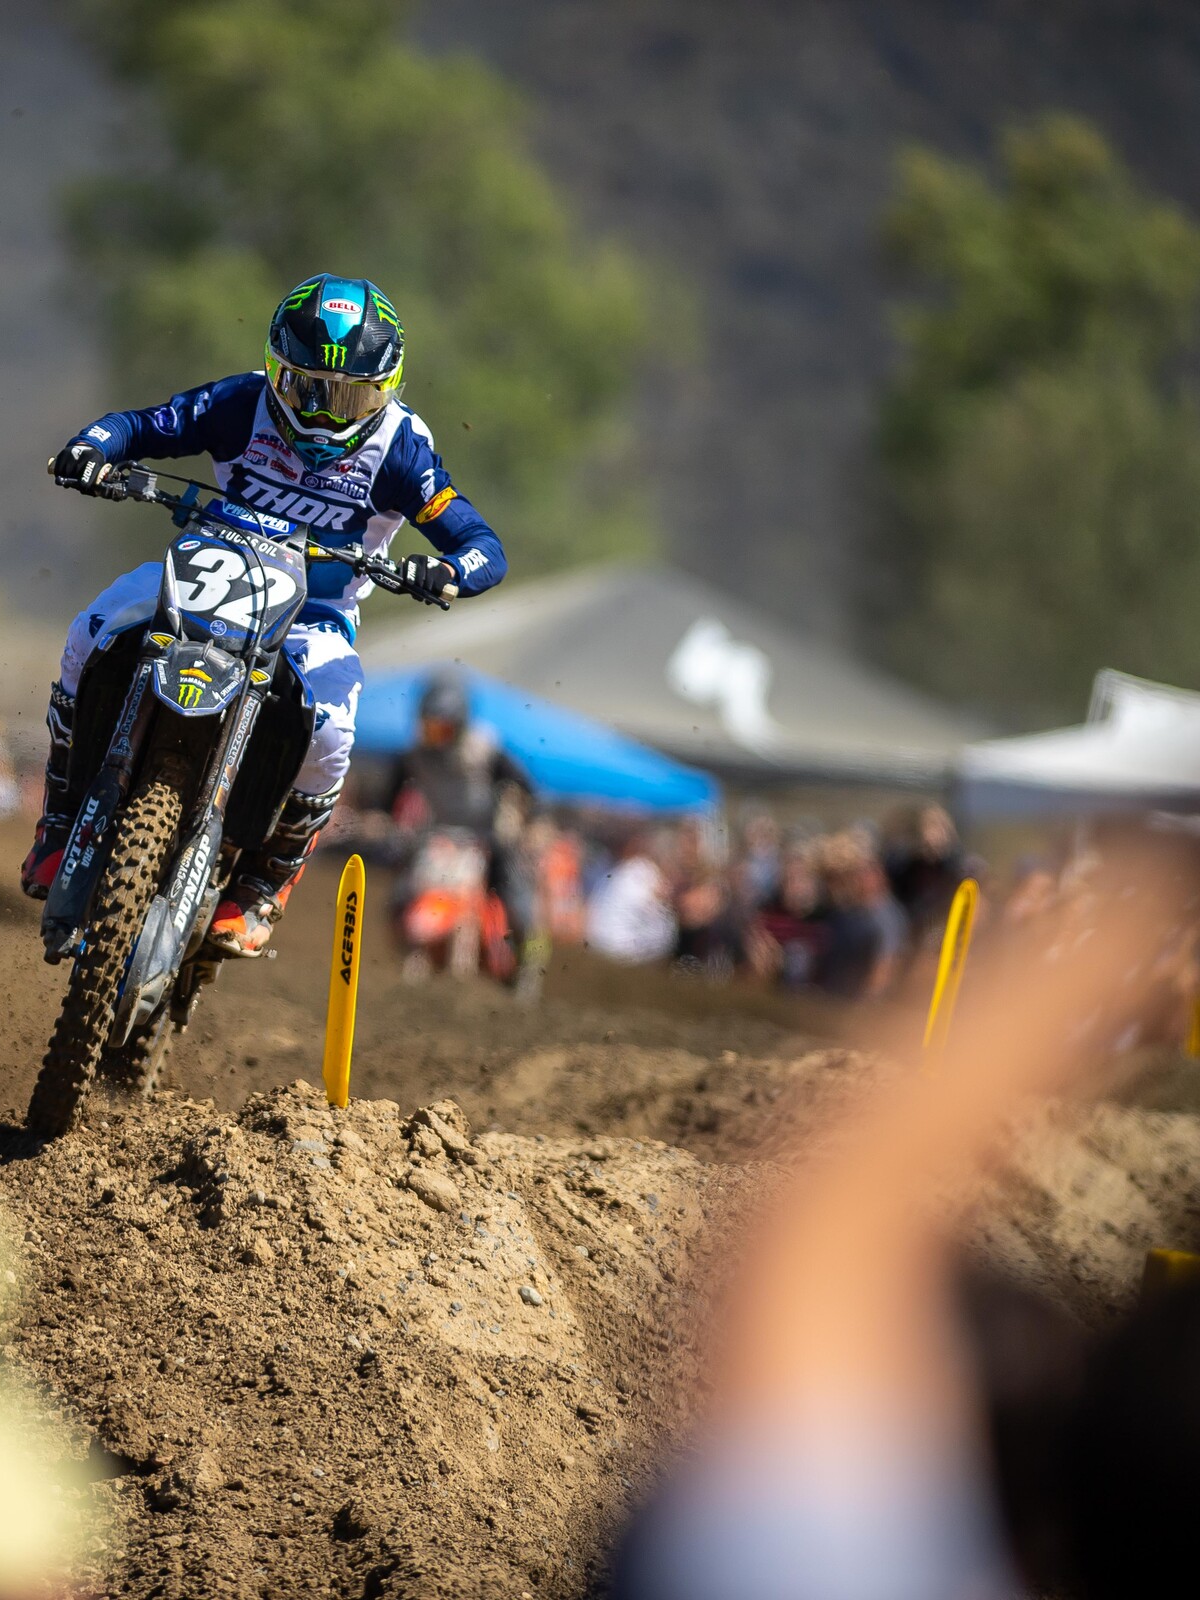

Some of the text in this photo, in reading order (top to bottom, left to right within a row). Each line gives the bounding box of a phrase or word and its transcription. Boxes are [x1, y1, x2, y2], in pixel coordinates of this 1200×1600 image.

[329, 302, 356, 311] BELL
[81, 461, 96, 483] THOR
[320, 479, 366, 499] YAMAHA
[240, 475, 355, 530] THOR
[217, 529, 258, 550] LUCAS
[258, 540, 279, 557] OIL
[175, 548, 297, 633] 32
[179, 676, 207, 689] YAMAHA
[227, 696, 259, 767] enzoracin
[177, 846, 195, 880] CYCRA
[174, 833, 211, 934] DUNLOP
[340, 890, 358, 986] ACERBIS
